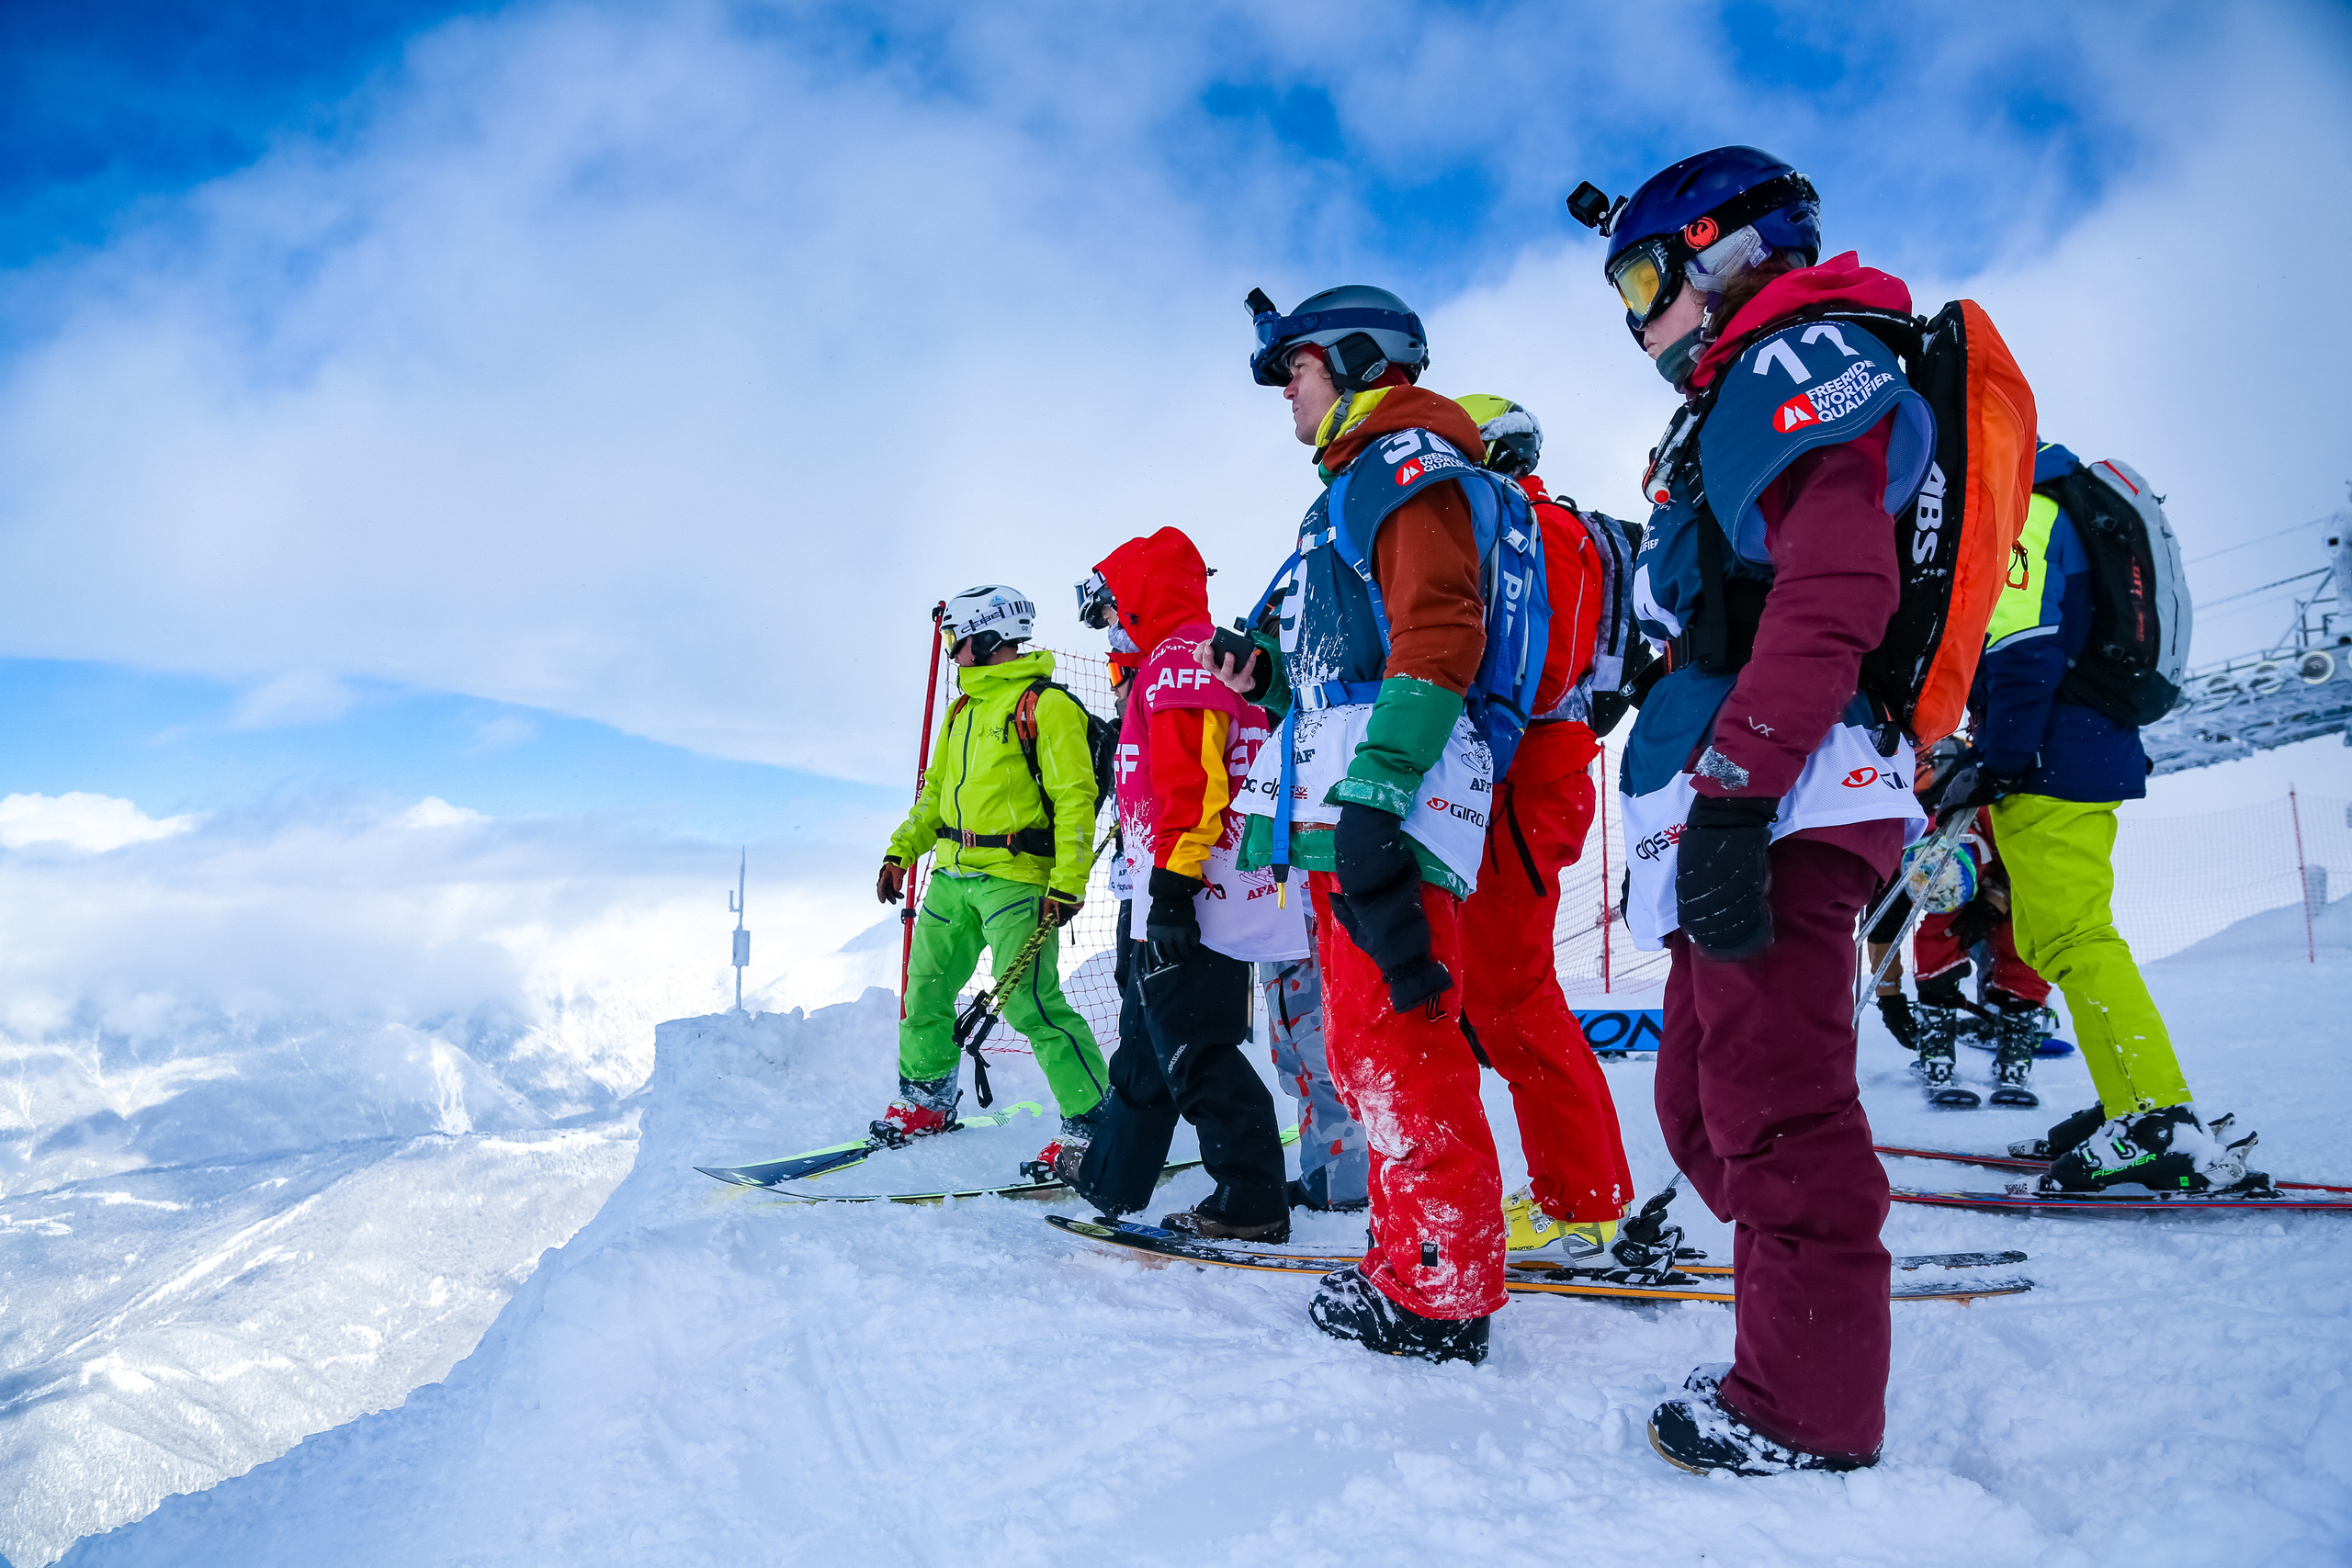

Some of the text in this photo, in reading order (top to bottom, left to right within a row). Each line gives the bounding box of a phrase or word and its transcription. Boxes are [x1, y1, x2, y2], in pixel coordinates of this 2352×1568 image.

[1804, 359, 1876, 400] FREERIDE
[1810, 371, 1871, 412] WORLD
[1817, 372, 1895, 423] QUALIFIER
[1912, 461, 1947, 564] ABS
[1450, 803, 1485, 828] GIRO
